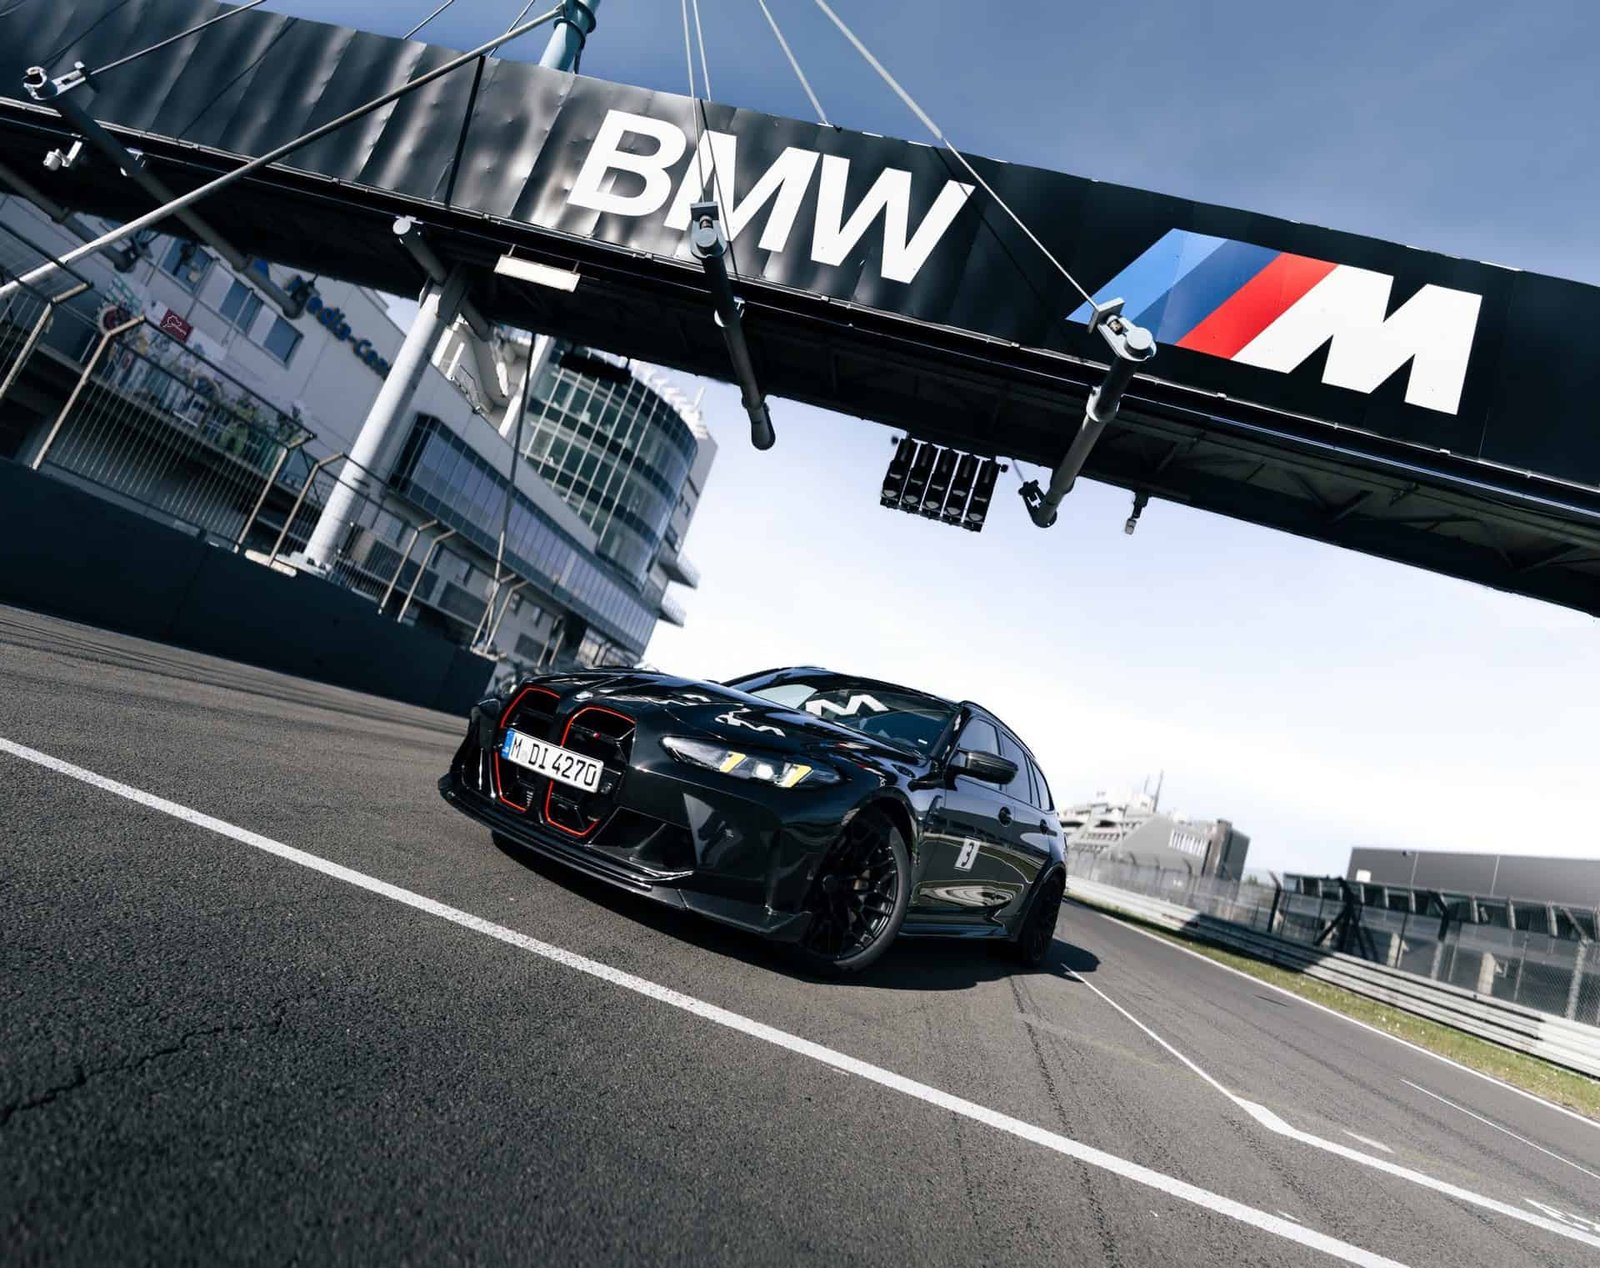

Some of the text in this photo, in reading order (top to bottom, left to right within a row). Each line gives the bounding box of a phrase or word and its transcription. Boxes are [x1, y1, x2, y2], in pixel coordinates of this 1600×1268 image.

[566, 109, 976, 284] BMW
[510, 736, 597, 787] M DI 4270
